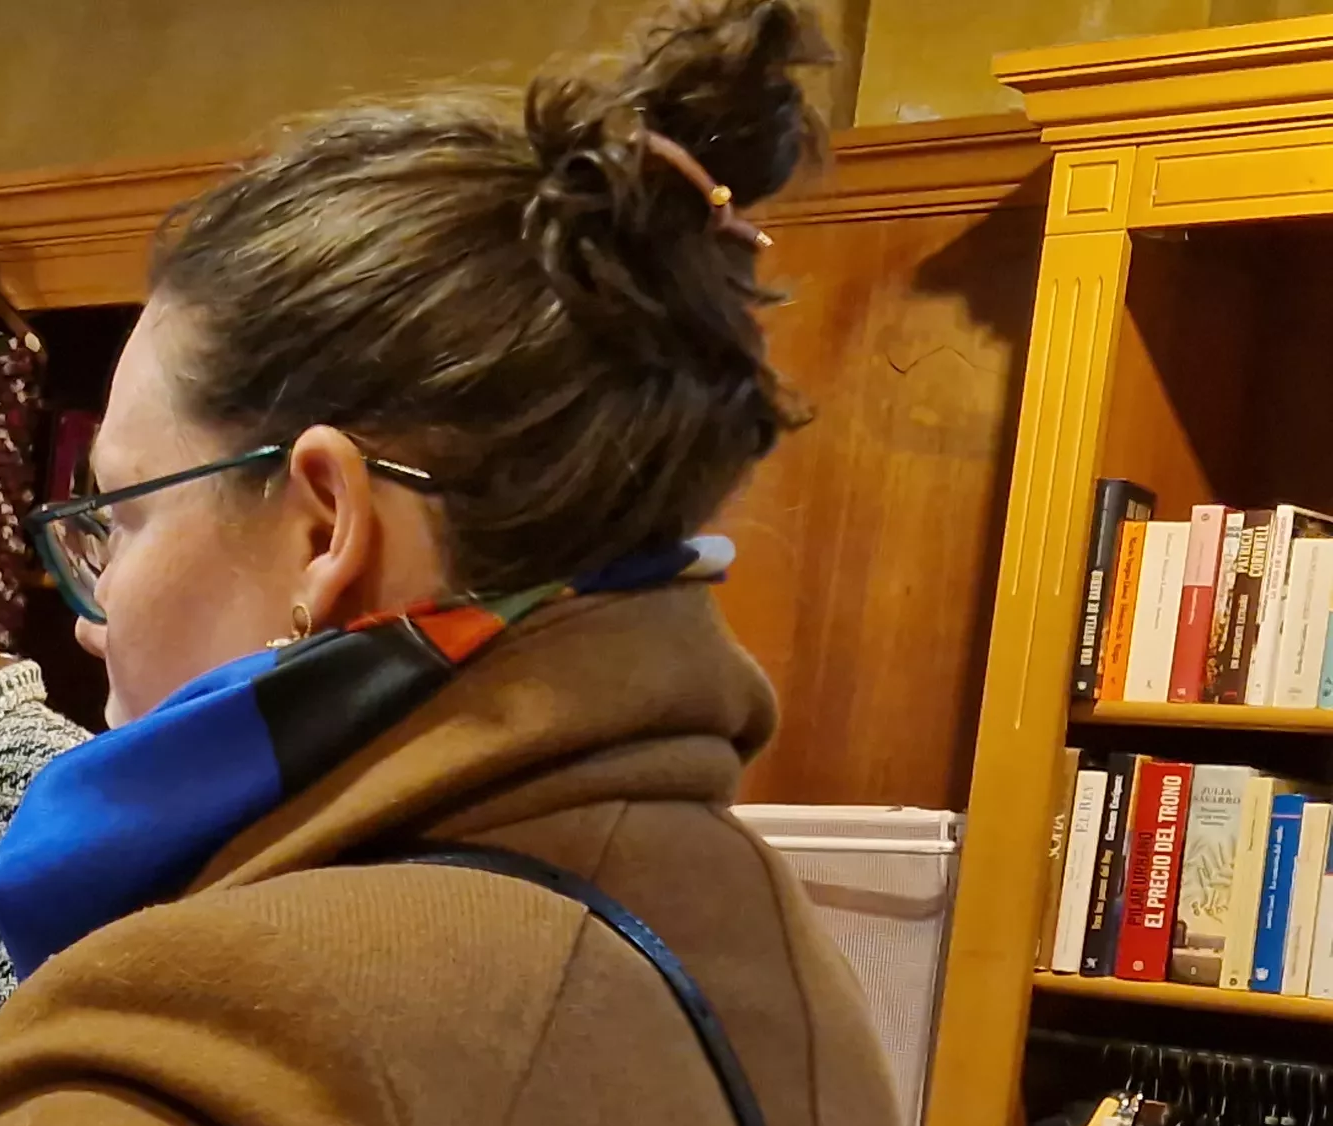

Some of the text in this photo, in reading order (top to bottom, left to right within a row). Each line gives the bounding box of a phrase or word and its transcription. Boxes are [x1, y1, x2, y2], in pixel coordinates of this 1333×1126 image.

[1237, 528, 1254, 573] PATRICIA
[1248, 525, 1269, 577] CORNWELL
[1075, 812, 1090, 833] EL
[1079, 786, 1094, 812] REY
[1144, 774, 1183, 929] EL PRECIO DEL TRONO
[1127, 832, 1154, 926] PILAR URBANO
